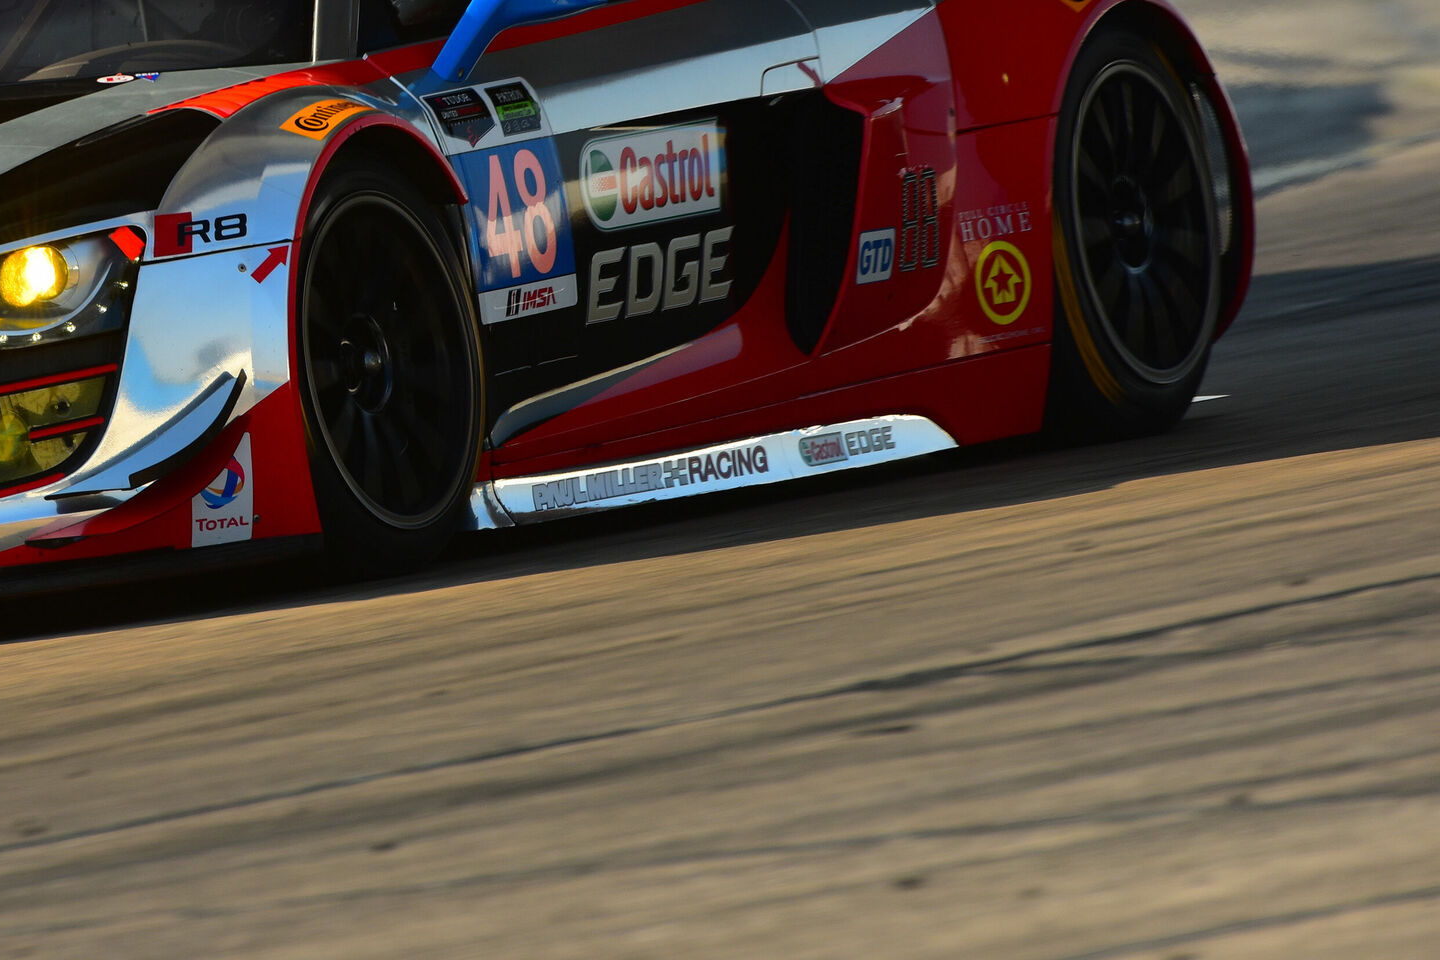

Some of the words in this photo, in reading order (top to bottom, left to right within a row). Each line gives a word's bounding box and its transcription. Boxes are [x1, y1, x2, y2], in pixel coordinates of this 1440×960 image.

[619, 133, 716, 215] Castrol
[177, 213, 247, 247] R8
[486, 149, 557, 279] 48
[960, 211, 1032, 242] HOME
[860, 238, 893, 276] GTD
[585, 225, 735, 326] EDGE
[522, 286, 557, 311] IMSA
[810, 437, 846, 461] Castrol
[845, 426, 896, 456] EDGE
[688, 445, 769, 484] RACING
[195, 515, 249, 532] TOTAL
